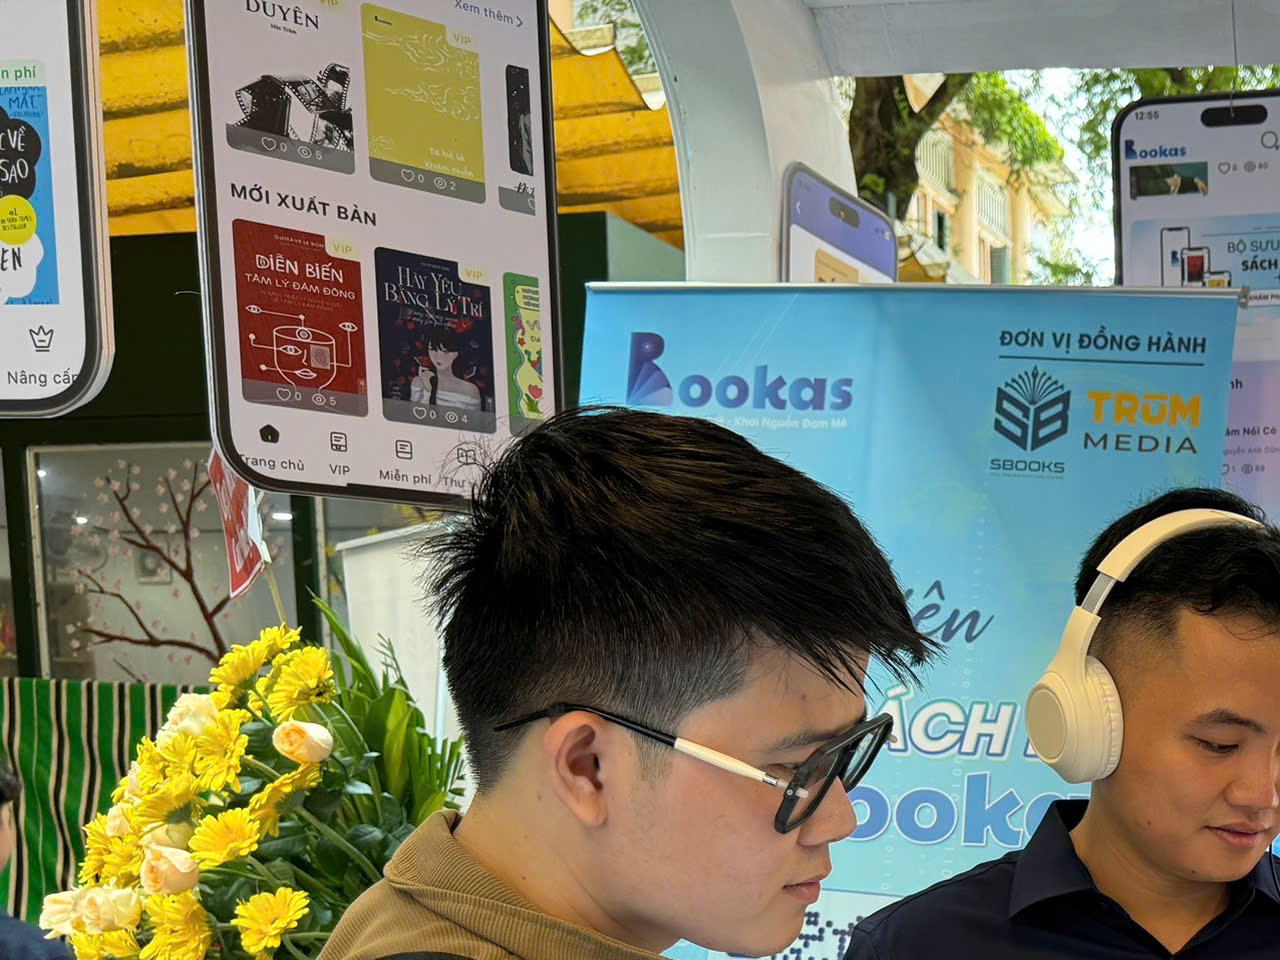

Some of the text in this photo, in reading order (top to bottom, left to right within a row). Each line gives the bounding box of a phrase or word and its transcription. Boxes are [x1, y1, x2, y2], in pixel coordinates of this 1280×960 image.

[246, 0, 319, 30] DUYÊN
[454, 0, 514, 25] Xem thêm
[453, 33, 471, 44] VIP
[14, 65, 36, 81] phí
[280, 142, 288, 152] 0
[1124, 139, 1187, 160] Bookas
[417, 174, 457, 191] 0 2
[230, 183, 377, 227] MỚI XUẤT BẢN
[333, 243, 353, 254] VIP
[1227, 239, 1247, 254] BỘ
[1250, 239, 1280, 252] SƯU
[1241, 254, 1279, 272] SÁCH
[465, 269, 483, 279] VIP
[275, 279, 290, 288] LÝ
[323, 287, 356, 300] ĐÔNG
[999, 325, 1207, 354] ĐƠN VỊ ĐỒNG HÀNH
[7, 369, 48, 388] Nâng
[626, 331, 853, 411] Bookas
[294, 391, 337, 406] 0 5
[429, 410, 437, 419] 0
[1083, 431, 1198, 455] MEDIA
[280, 457, 305, 471] chủ
[329, 464, 351, 475] VIP
[989, 458, 1065, 474] SBOOKS
[379, 469, 432, 486] Miễn phí
[910, 580, 994, 643] ên
[872, 681, 1018, 758] ÁCH
